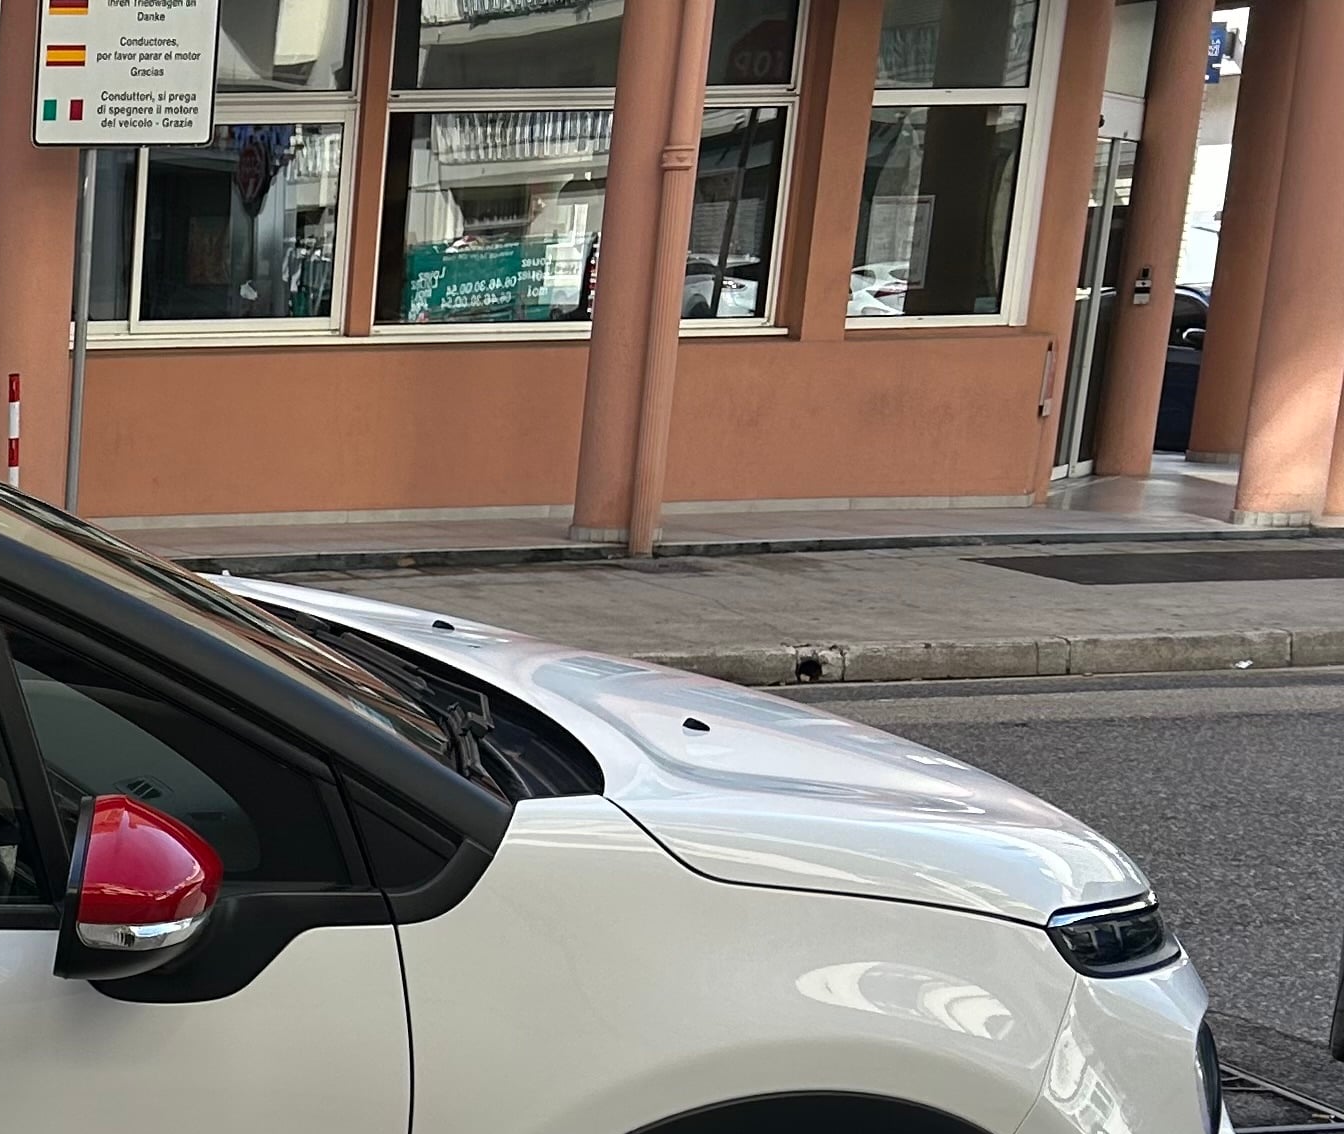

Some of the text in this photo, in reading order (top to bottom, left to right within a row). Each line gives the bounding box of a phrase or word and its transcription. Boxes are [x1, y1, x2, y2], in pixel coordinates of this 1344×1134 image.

[137, 12, 165, 21] Danke
[120, 36, 179, 47] Conductores,
[96, 51, 201, 62] por favor parar el motor
[130, 66, 164, 77] Gracias
[101, 91, 197, 103] Conduttori, si prega
[96, 105, 199, 116] di spegnere il motore
[101, 118, 116, 128] del
[119, 118, 153, 128] veicolo
[162, 118, 193, 128] Grazie
